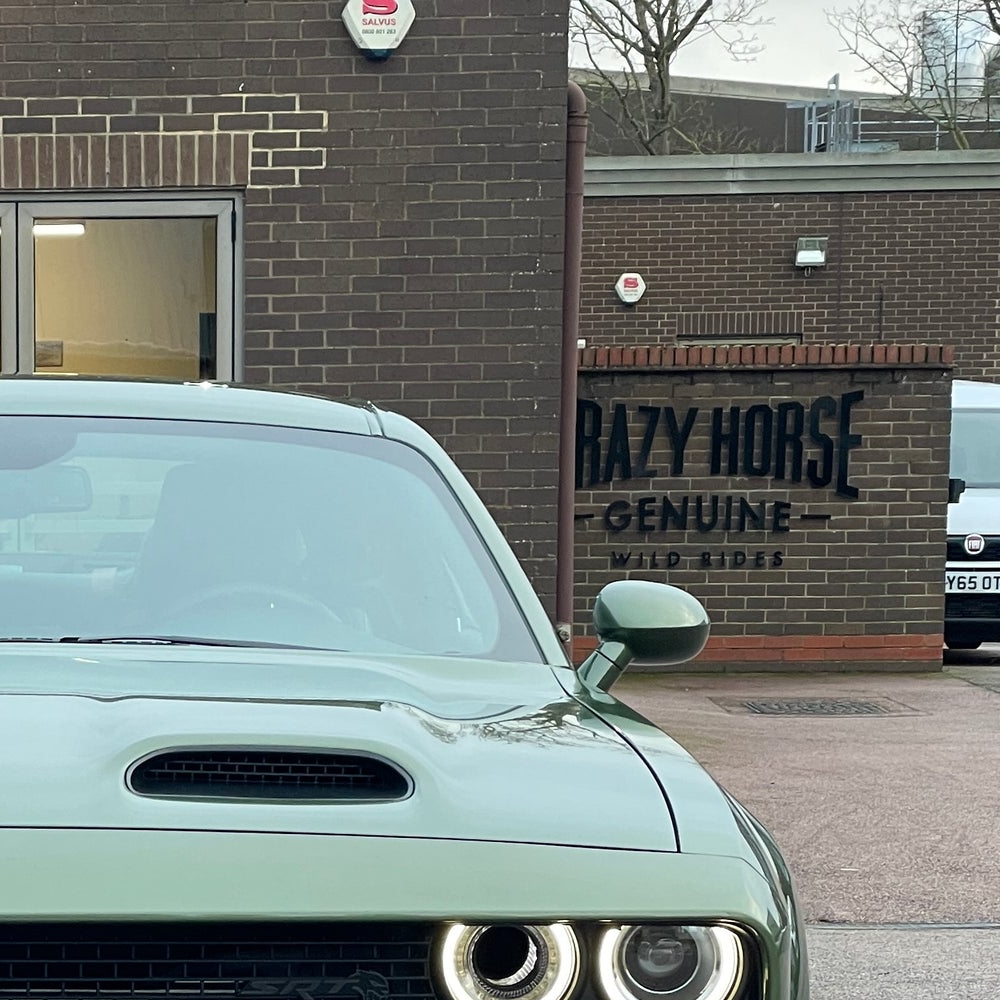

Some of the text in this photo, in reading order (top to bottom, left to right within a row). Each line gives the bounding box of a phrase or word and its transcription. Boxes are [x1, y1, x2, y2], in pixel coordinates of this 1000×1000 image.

[362, 18, 396, 26] SALVUS
[575, 390, 864, 499] RAZY HORSE
[604, 495, 791, 533] GENUINE
[611, 551, 784, 567] WILD RIDES
[946, 575, 978, 590] Y65
[240, 979, 361, 1000] SRT
